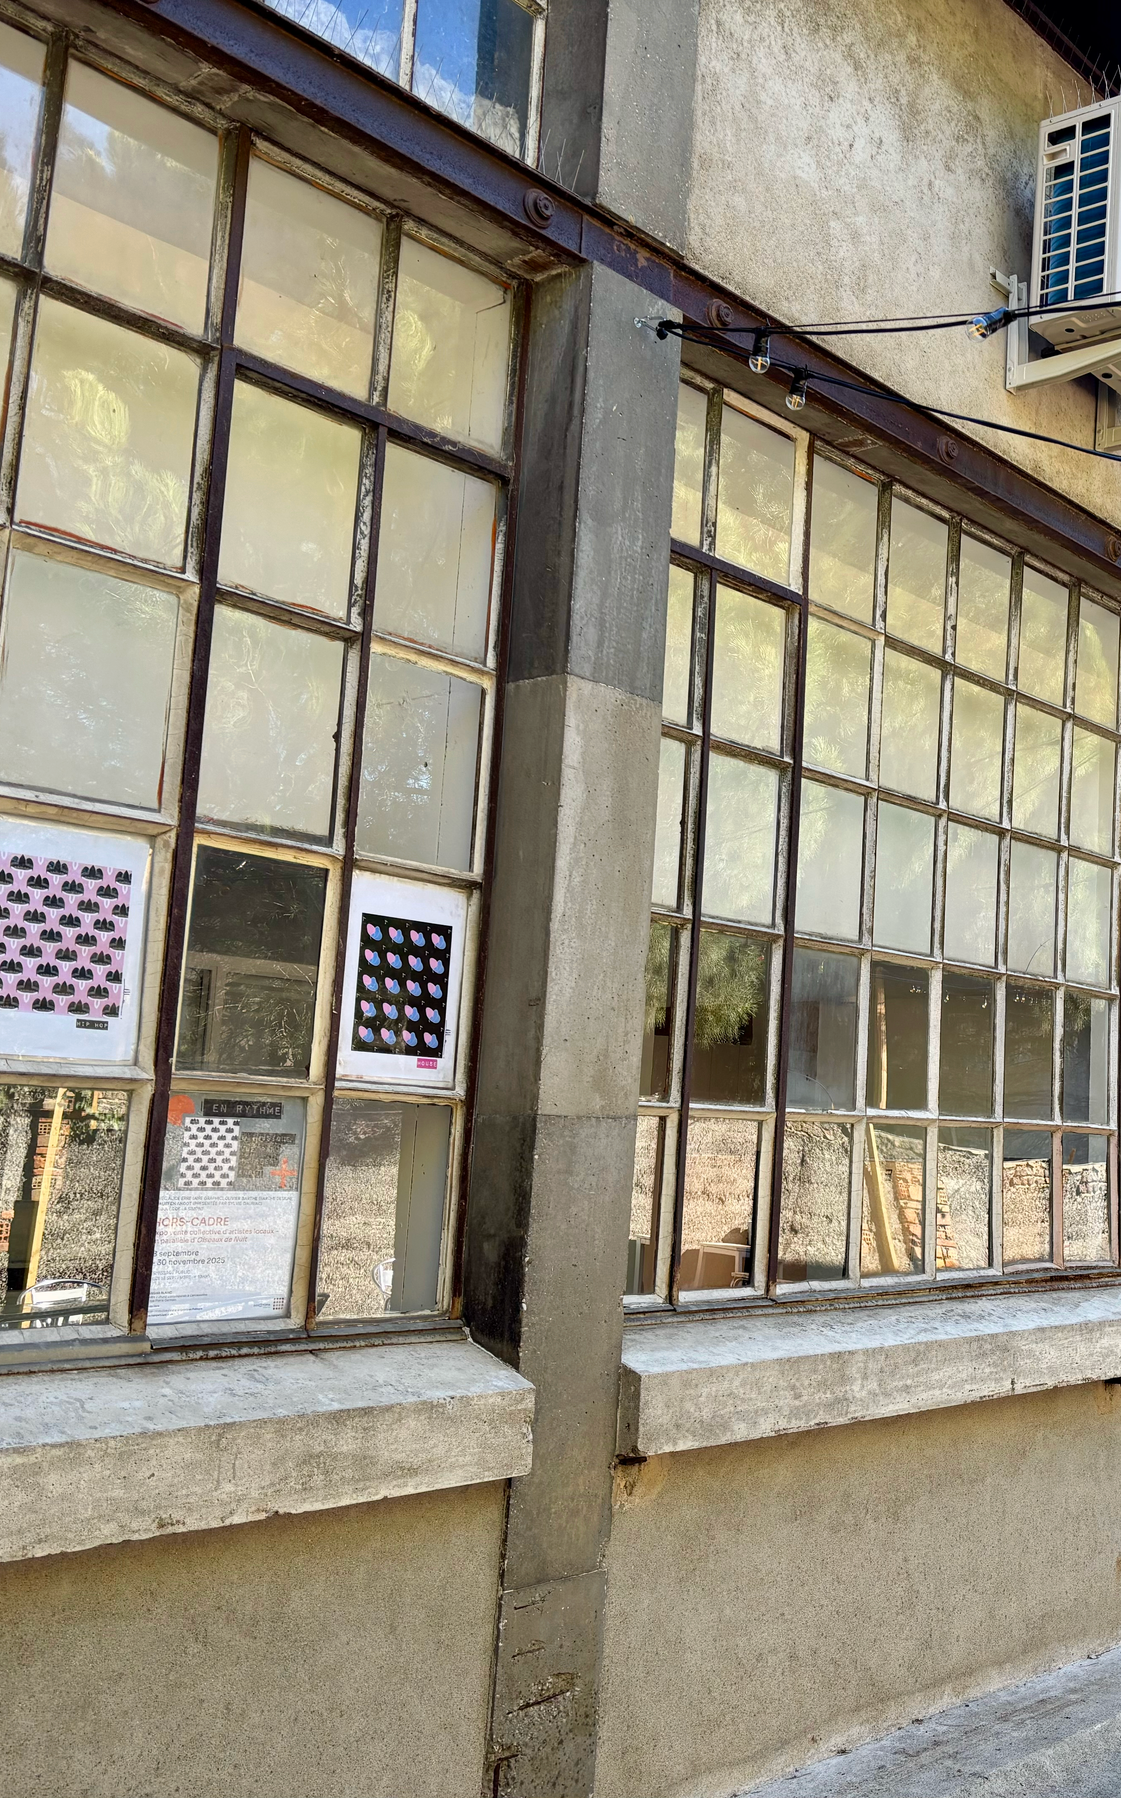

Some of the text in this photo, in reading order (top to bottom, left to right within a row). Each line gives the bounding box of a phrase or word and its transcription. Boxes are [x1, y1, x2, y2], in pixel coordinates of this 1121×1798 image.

[212, 1103, 281, 1116] EN RYTHME
[158, 1250, 200, 1258] septembre
[157, 1258, 167, 1266] 30
[168, 1258, 206, 1266] novembre
[206, 1256, 226, 1264] 2025
